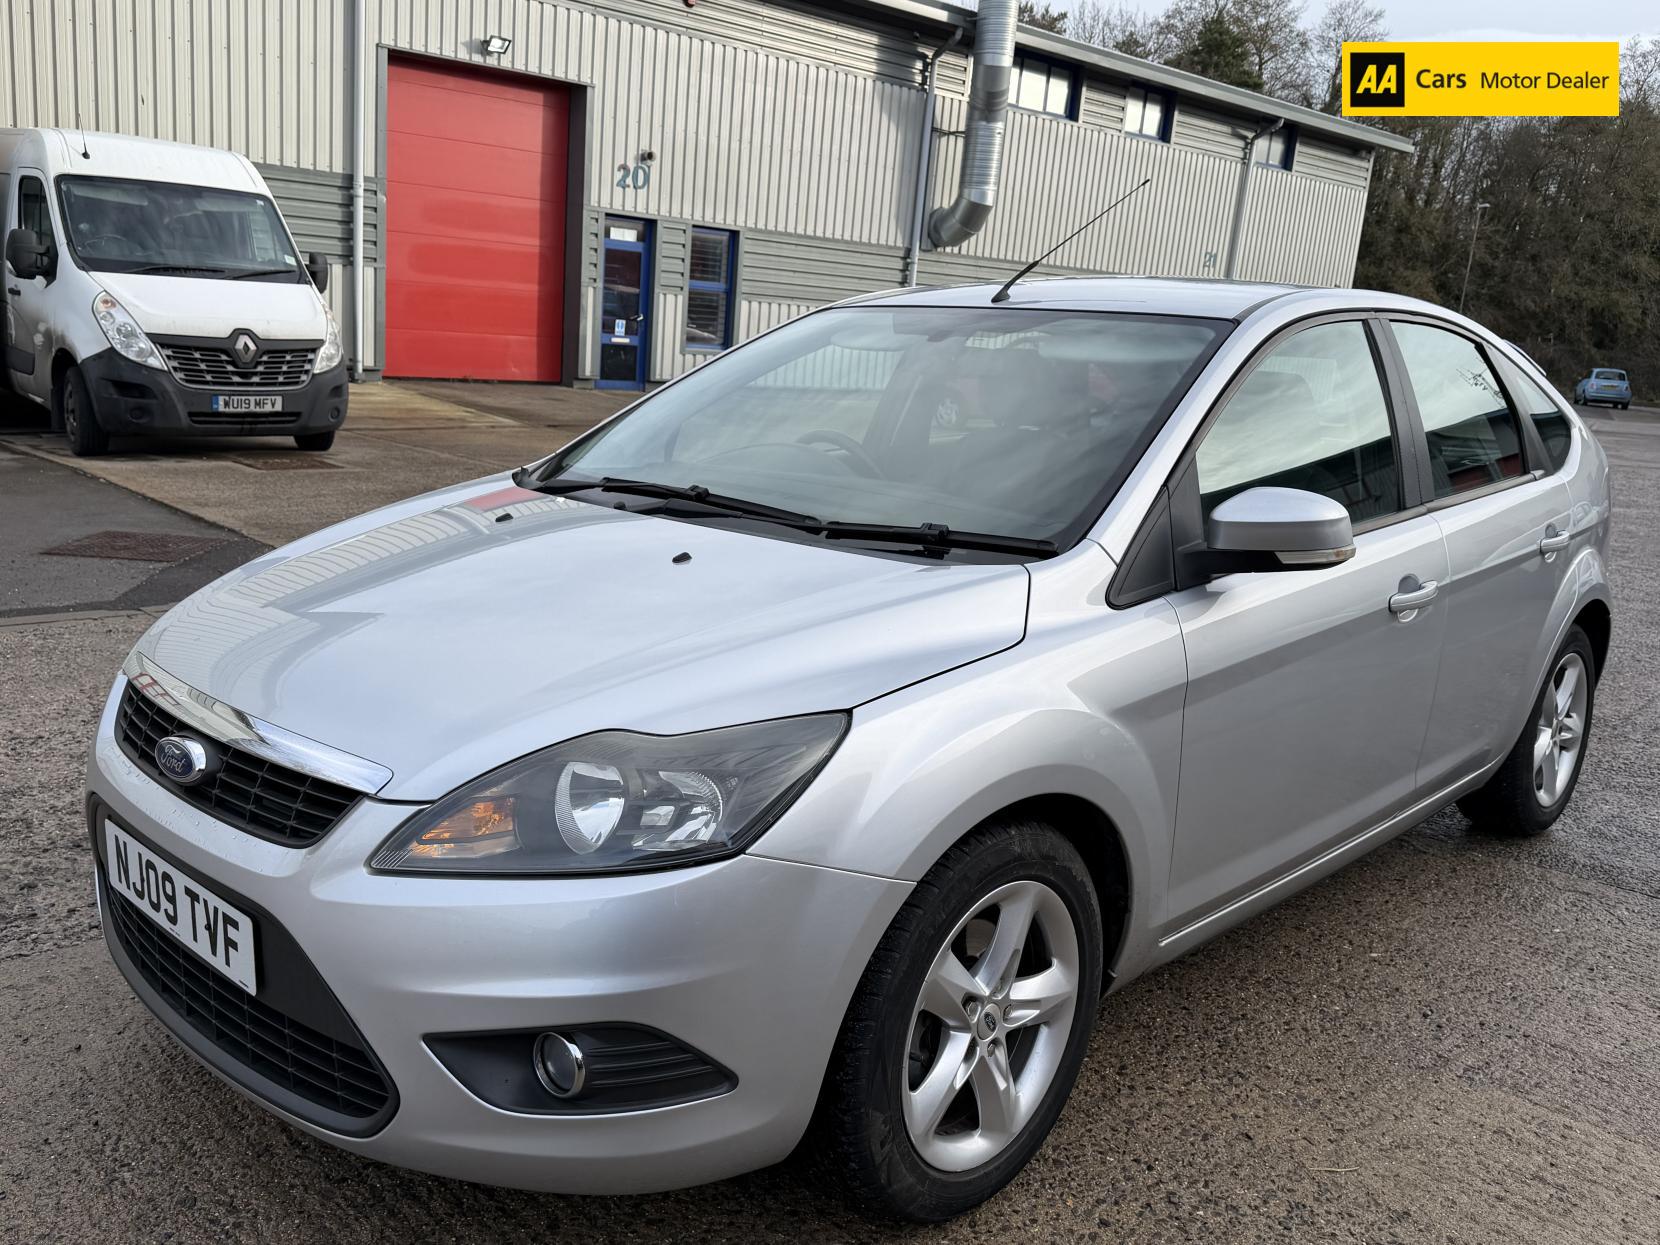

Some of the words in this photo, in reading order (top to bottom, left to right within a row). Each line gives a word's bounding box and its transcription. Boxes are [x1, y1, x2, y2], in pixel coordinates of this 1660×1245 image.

[616, 163, 649, 190] 20
[1203, 251, 1217, 268] 21
[223, 397, 250, 410] WU19
[254, 397, 277, 410] MFV
[160, 744, 186, 773] Ford
[114, 834, 178, 926] NJ09
[184, 885, 240, 968] TVF
